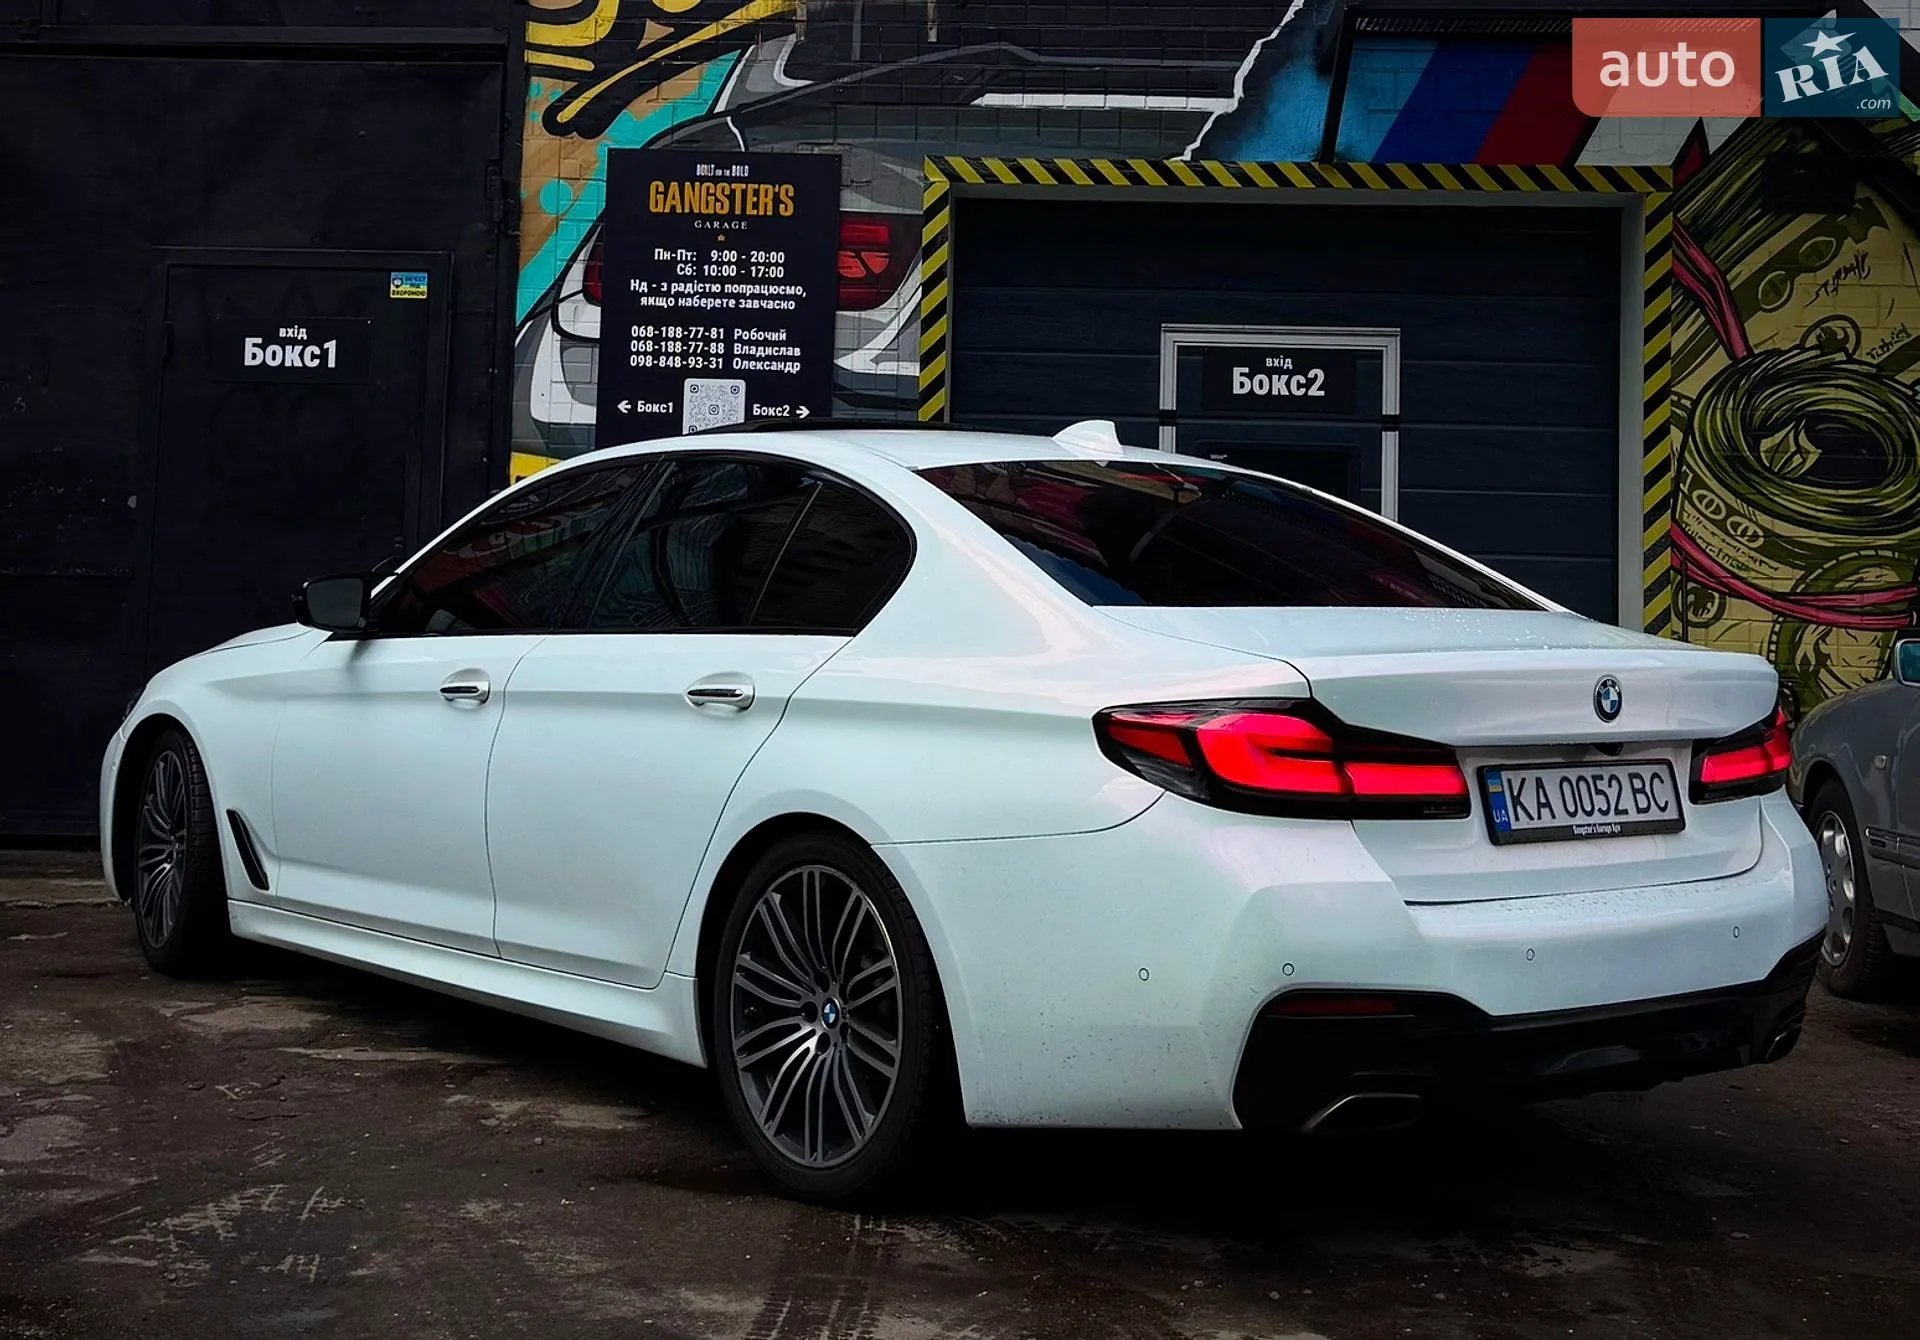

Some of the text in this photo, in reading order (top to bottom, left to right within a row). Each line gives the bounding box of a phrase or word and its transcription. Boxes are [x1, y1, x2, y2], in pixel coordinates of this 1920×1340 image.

[649, 180, 795, 216] GANGSTER'S
[694, 219, 748, 230] GARAGE
[654, 248, 697, 262] Пн-Пт:
[710, 249, 738, 262] 9:00
[750, 251, 785, 264] 20:00
[676, 263, 697, 276] Сб:
[703, 265, 737, 277] 10:00
[750, 266, 785, 278] 17:00
[630, 279, 648, 293] Нд
[660, 282, 668, 292] з
[671, 280, 722, 295] радістю
[724, 284, 807, 298] попрацюємо,
[640, 295, 796, 310] якщо наберете завчасно
[279, 325, 307, 340] вхід
[631, 325, 787, 342] 068-188-77-81 Робочий
[244, 337, 337, 368] Бокс1
[630, 340, 802, 358] 068-188-77-88 Владислав
[630, 355, 802, 374] 098-848-93-31 Олександр
[1265, 355, 1293, 370] вхід
[1232, 366, 1326, 397] Бокс2
[637, 400, 674, 414] Бокс1
[752, 403, 791, 417] Бокс2
[1507, 771, 1669, 822] KA 0052 BC
[1493, 808, 1510, 823] UA
